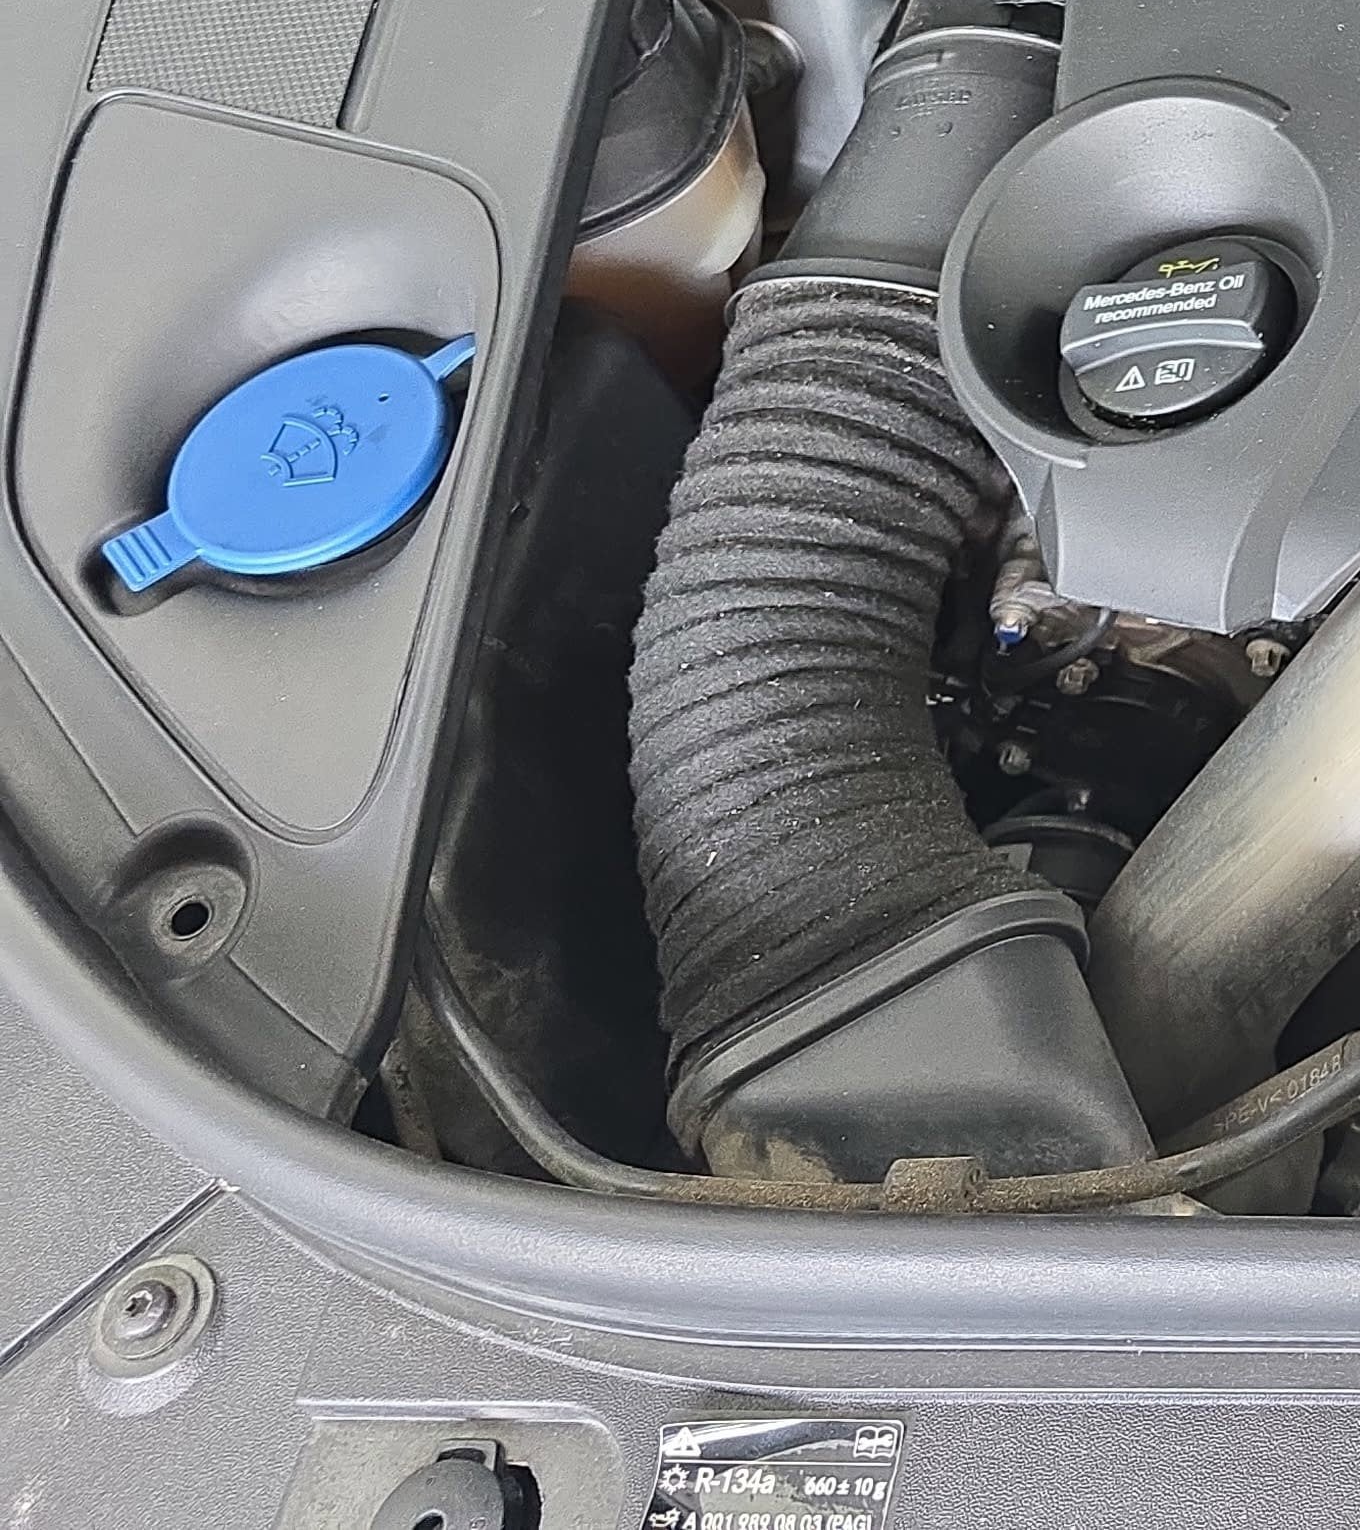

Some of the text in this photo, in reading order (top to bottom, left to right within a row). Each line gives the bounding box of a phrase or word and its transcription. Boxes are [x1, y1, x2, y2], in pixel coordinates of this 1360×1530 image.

[1083, 274, 1246, 312] Mercedes-Benz Oil
[1094, 294, 1218, 325] recommended
[694, 1467, 776, 1494] R-134a
